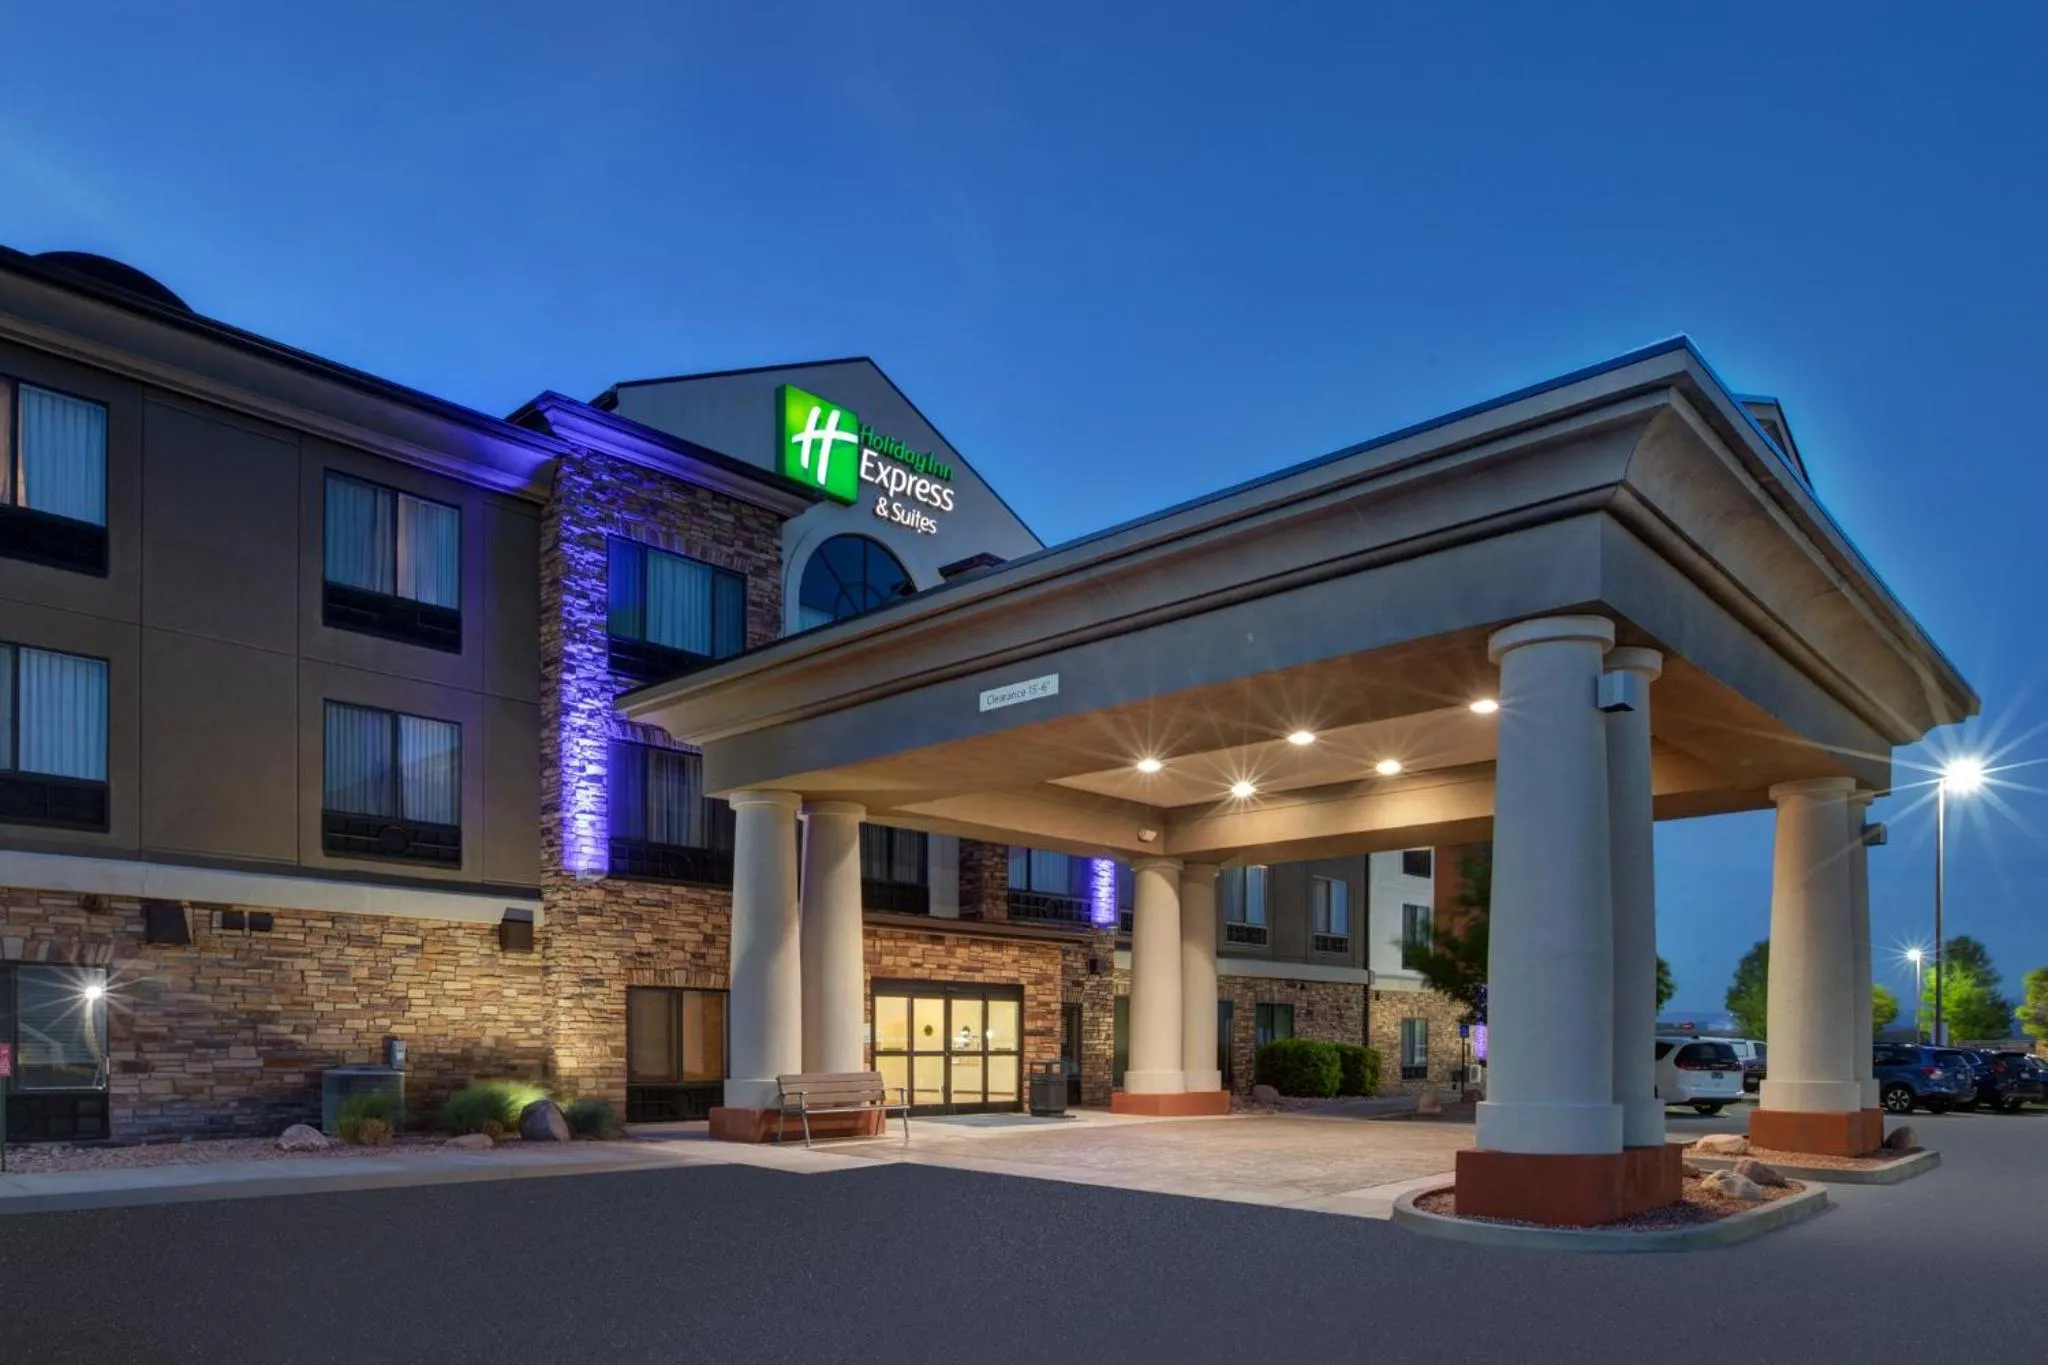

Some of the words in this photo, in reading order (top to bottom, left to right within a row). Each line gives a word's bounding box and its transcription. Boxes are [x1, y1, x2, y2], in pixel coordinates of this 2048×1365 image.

[860, 425, 927, 472] Holiday
[928, 452, 953, 480] Inn
[859, 448, 955, 512] Express
[876, 496, 889, 517] &
[891, 502, 937, 534] Suites
[986, 688, 1026, 705] Clearance
